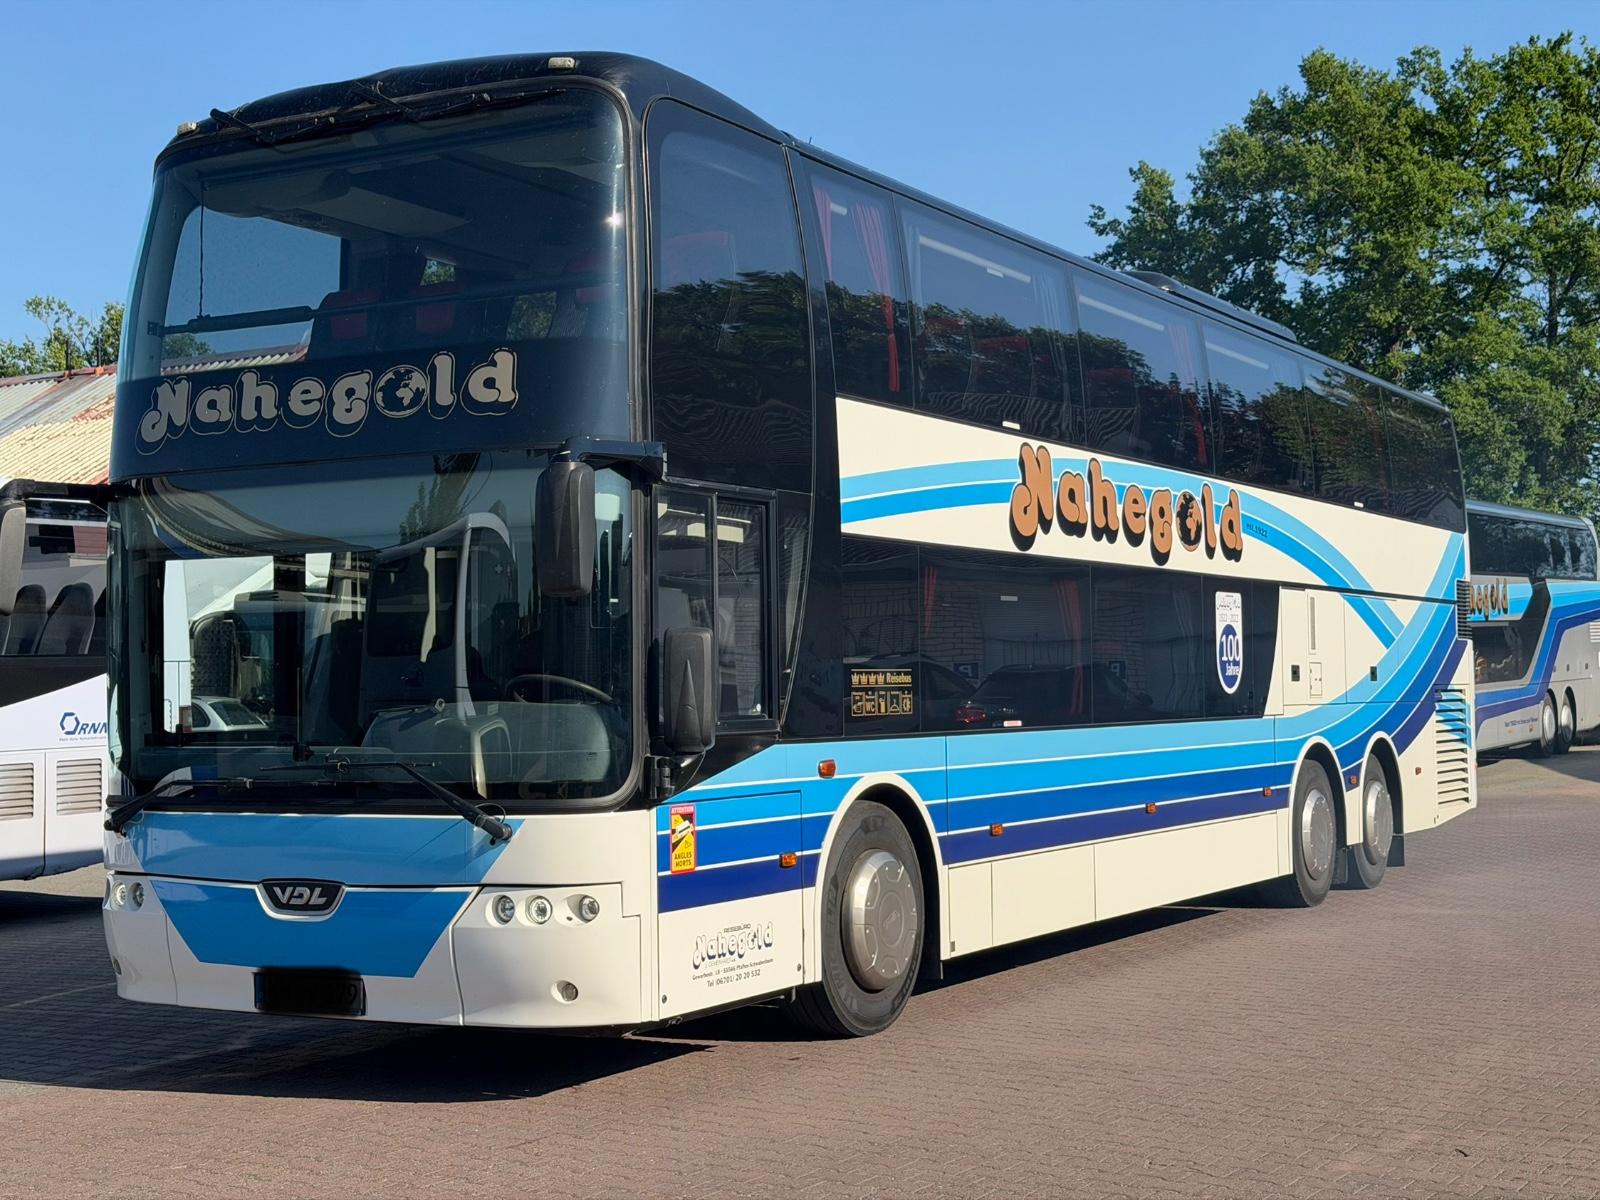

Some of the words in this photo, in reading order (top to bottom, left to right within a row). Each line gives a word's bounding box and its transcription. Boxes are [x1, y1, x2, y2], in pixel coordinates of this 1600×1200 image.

[136, 348, 519, 455] Nahegold
[1009, 442, 1243, 567] Nahegold
[1221, 634, 1240, 661] 100
[886, 672, 912, 684] Reisebus
[1225, 662, 1240, 677] Jahre
[865, 701, 875, 713] WC
[674, 852, 692, 860] ANGLES
[675, 859, 692, 868] MORTS
[273, 886, 328, 905] VDL
[693, 921, 774, 970] Nahegold
